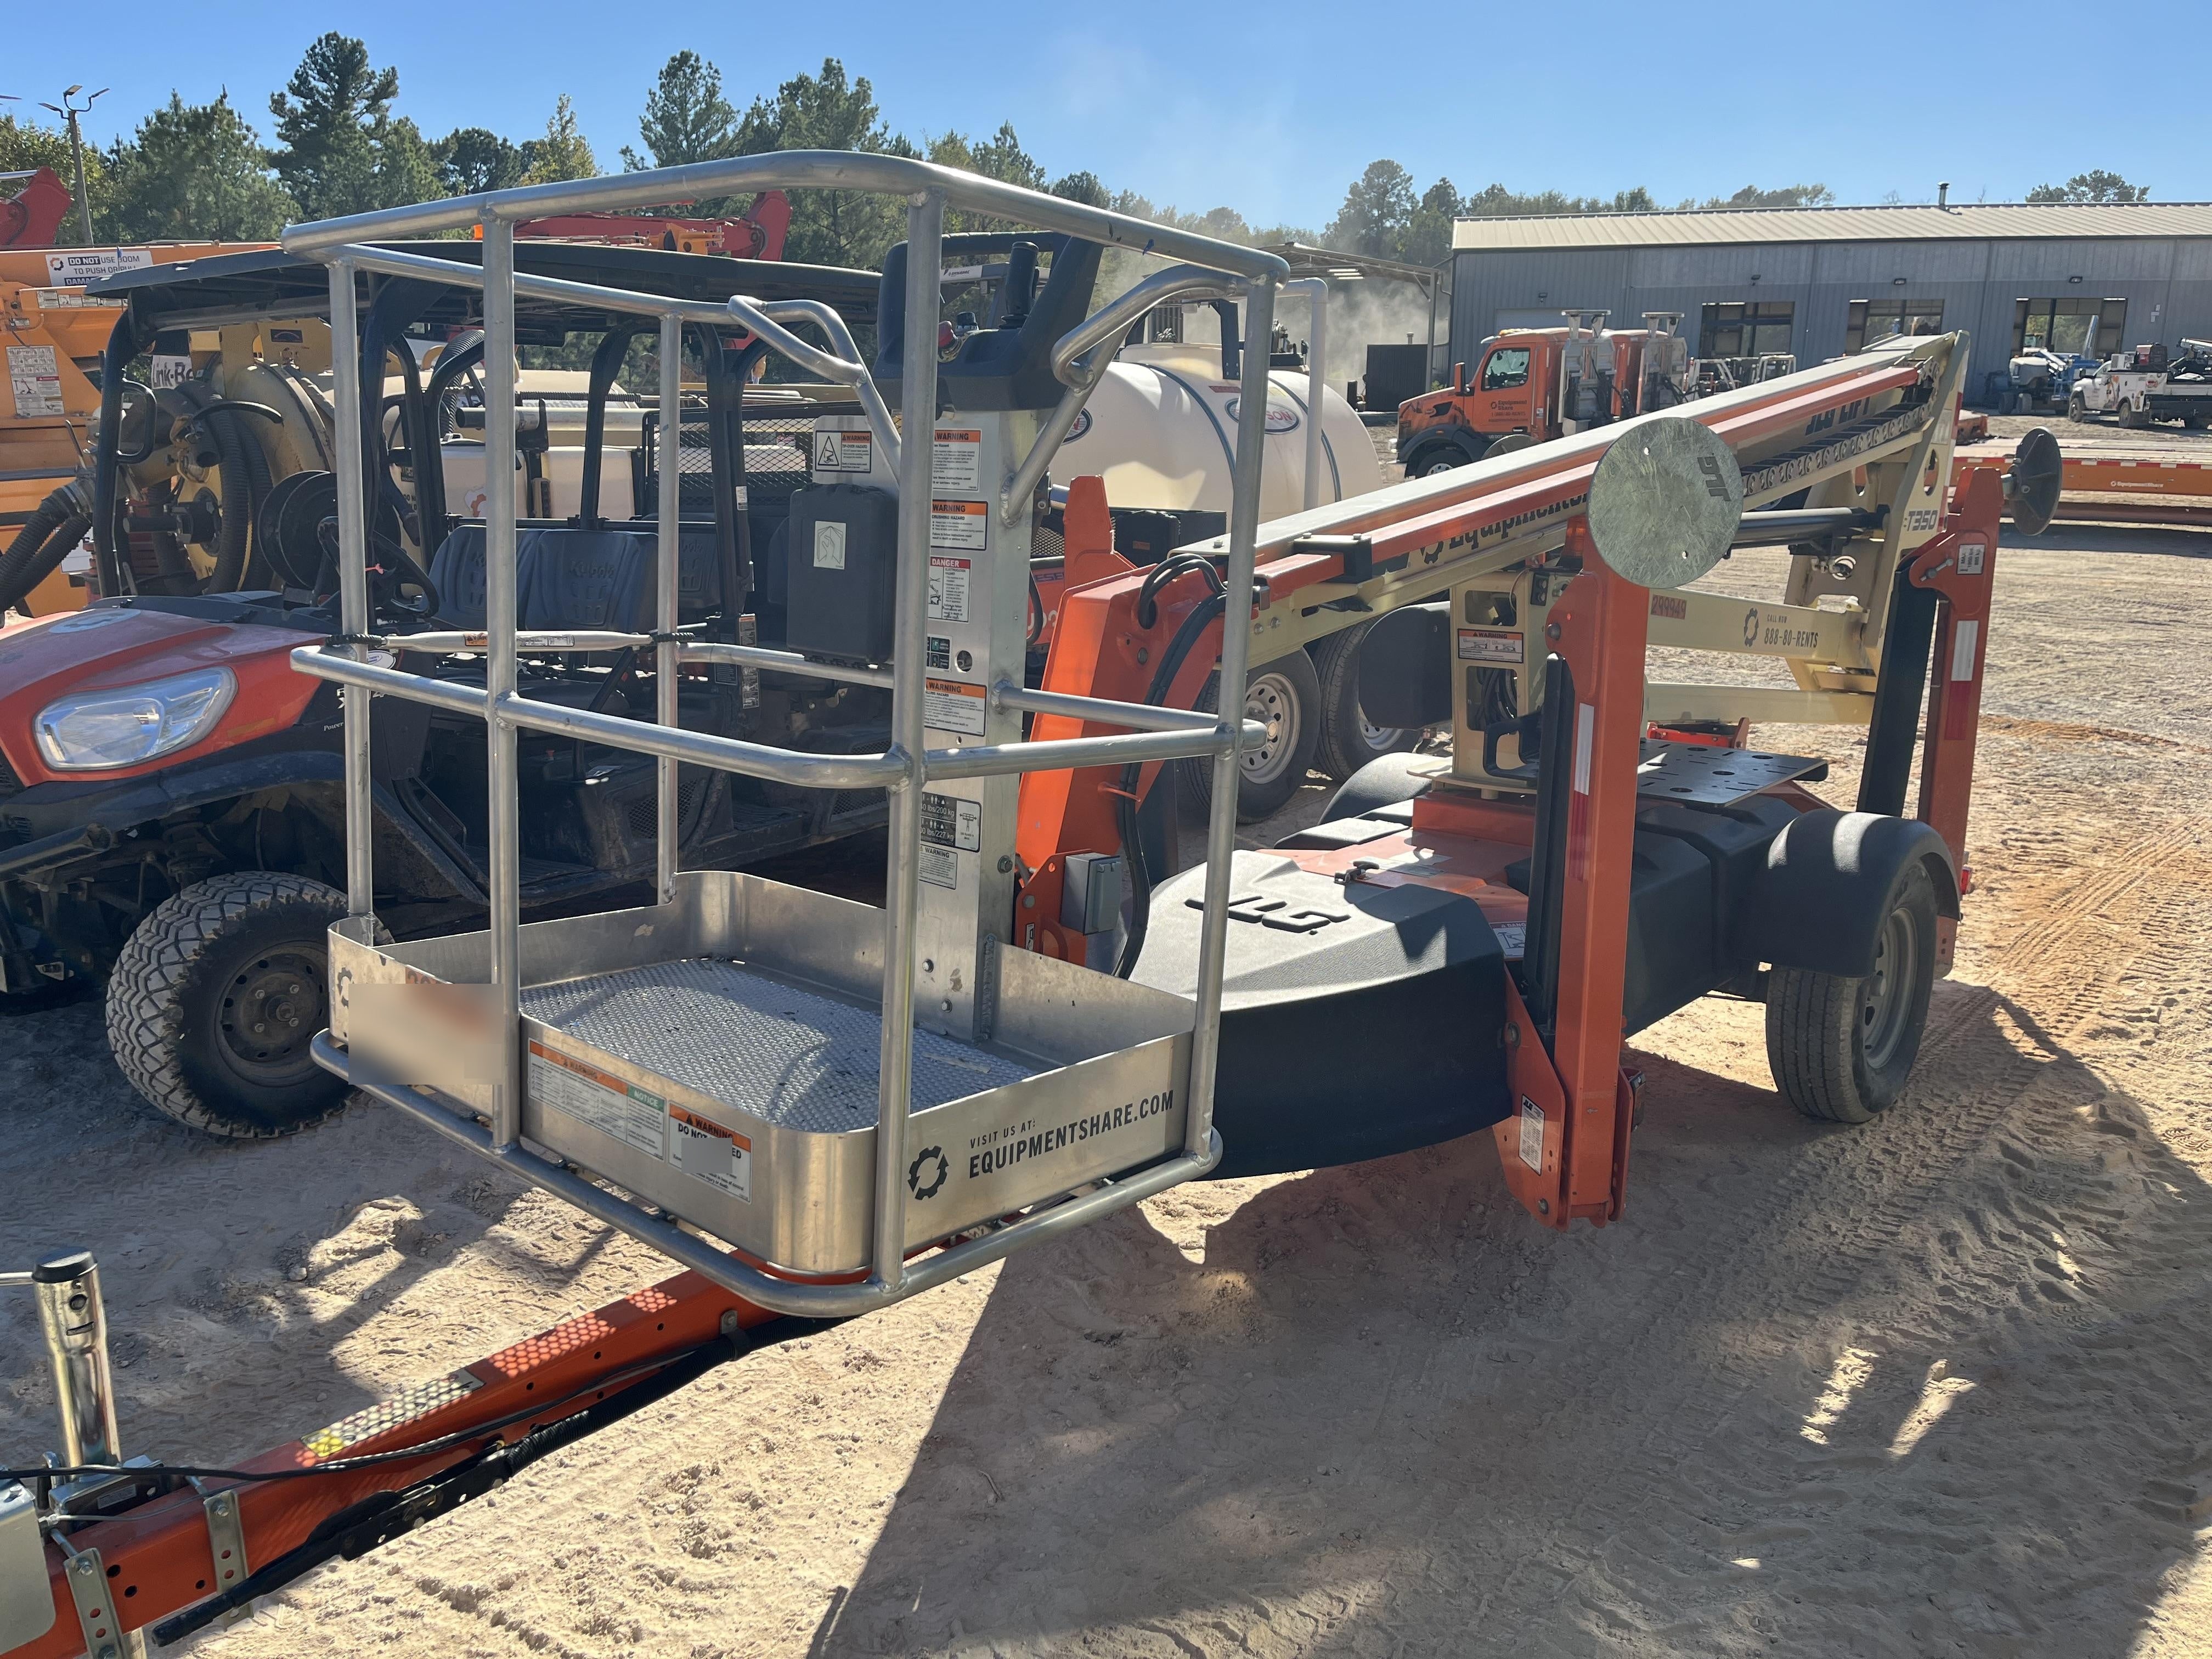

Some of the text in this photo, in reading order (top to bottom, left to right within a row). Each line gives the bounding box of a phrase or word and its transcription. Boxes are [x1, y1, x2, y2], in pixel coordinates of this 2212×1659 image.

[86, 266, 106, 274] PUSH
[108, 265, 119, 273] OR
[1697, 456, 1731, 502] JLG
[933, 504, 966, 512] WARNING
[1907, 510, 1939, 532] T350
[932, 558, 960, 567] DANGER
[1767, 614, 1778, 623] CALL
[1764, 627, 1819, 648] 888-80-RENTS
[929, 682, 962, 693] WARNING
[324, 721, 345, 731] Power
[927, 805, 947, 815] lbs/200
[947, 808, 955, 816] kg
[927, 828, 946, 838] lbs/227
[947, 832, 954, 842] kg
[925, 847, 950, 858] WARNING
[633, 1090, 659, 1108] NOTICE
[678, 1123, 689, 1135] DO
[695, 1118, 733, 1138] WARNING
[969, 1089, 1174, 1180] EQUIPMENTSHARE.COM
[970, 1131, 998, 1149] VISIT
[1003, 1125, 1015, 1138] US
